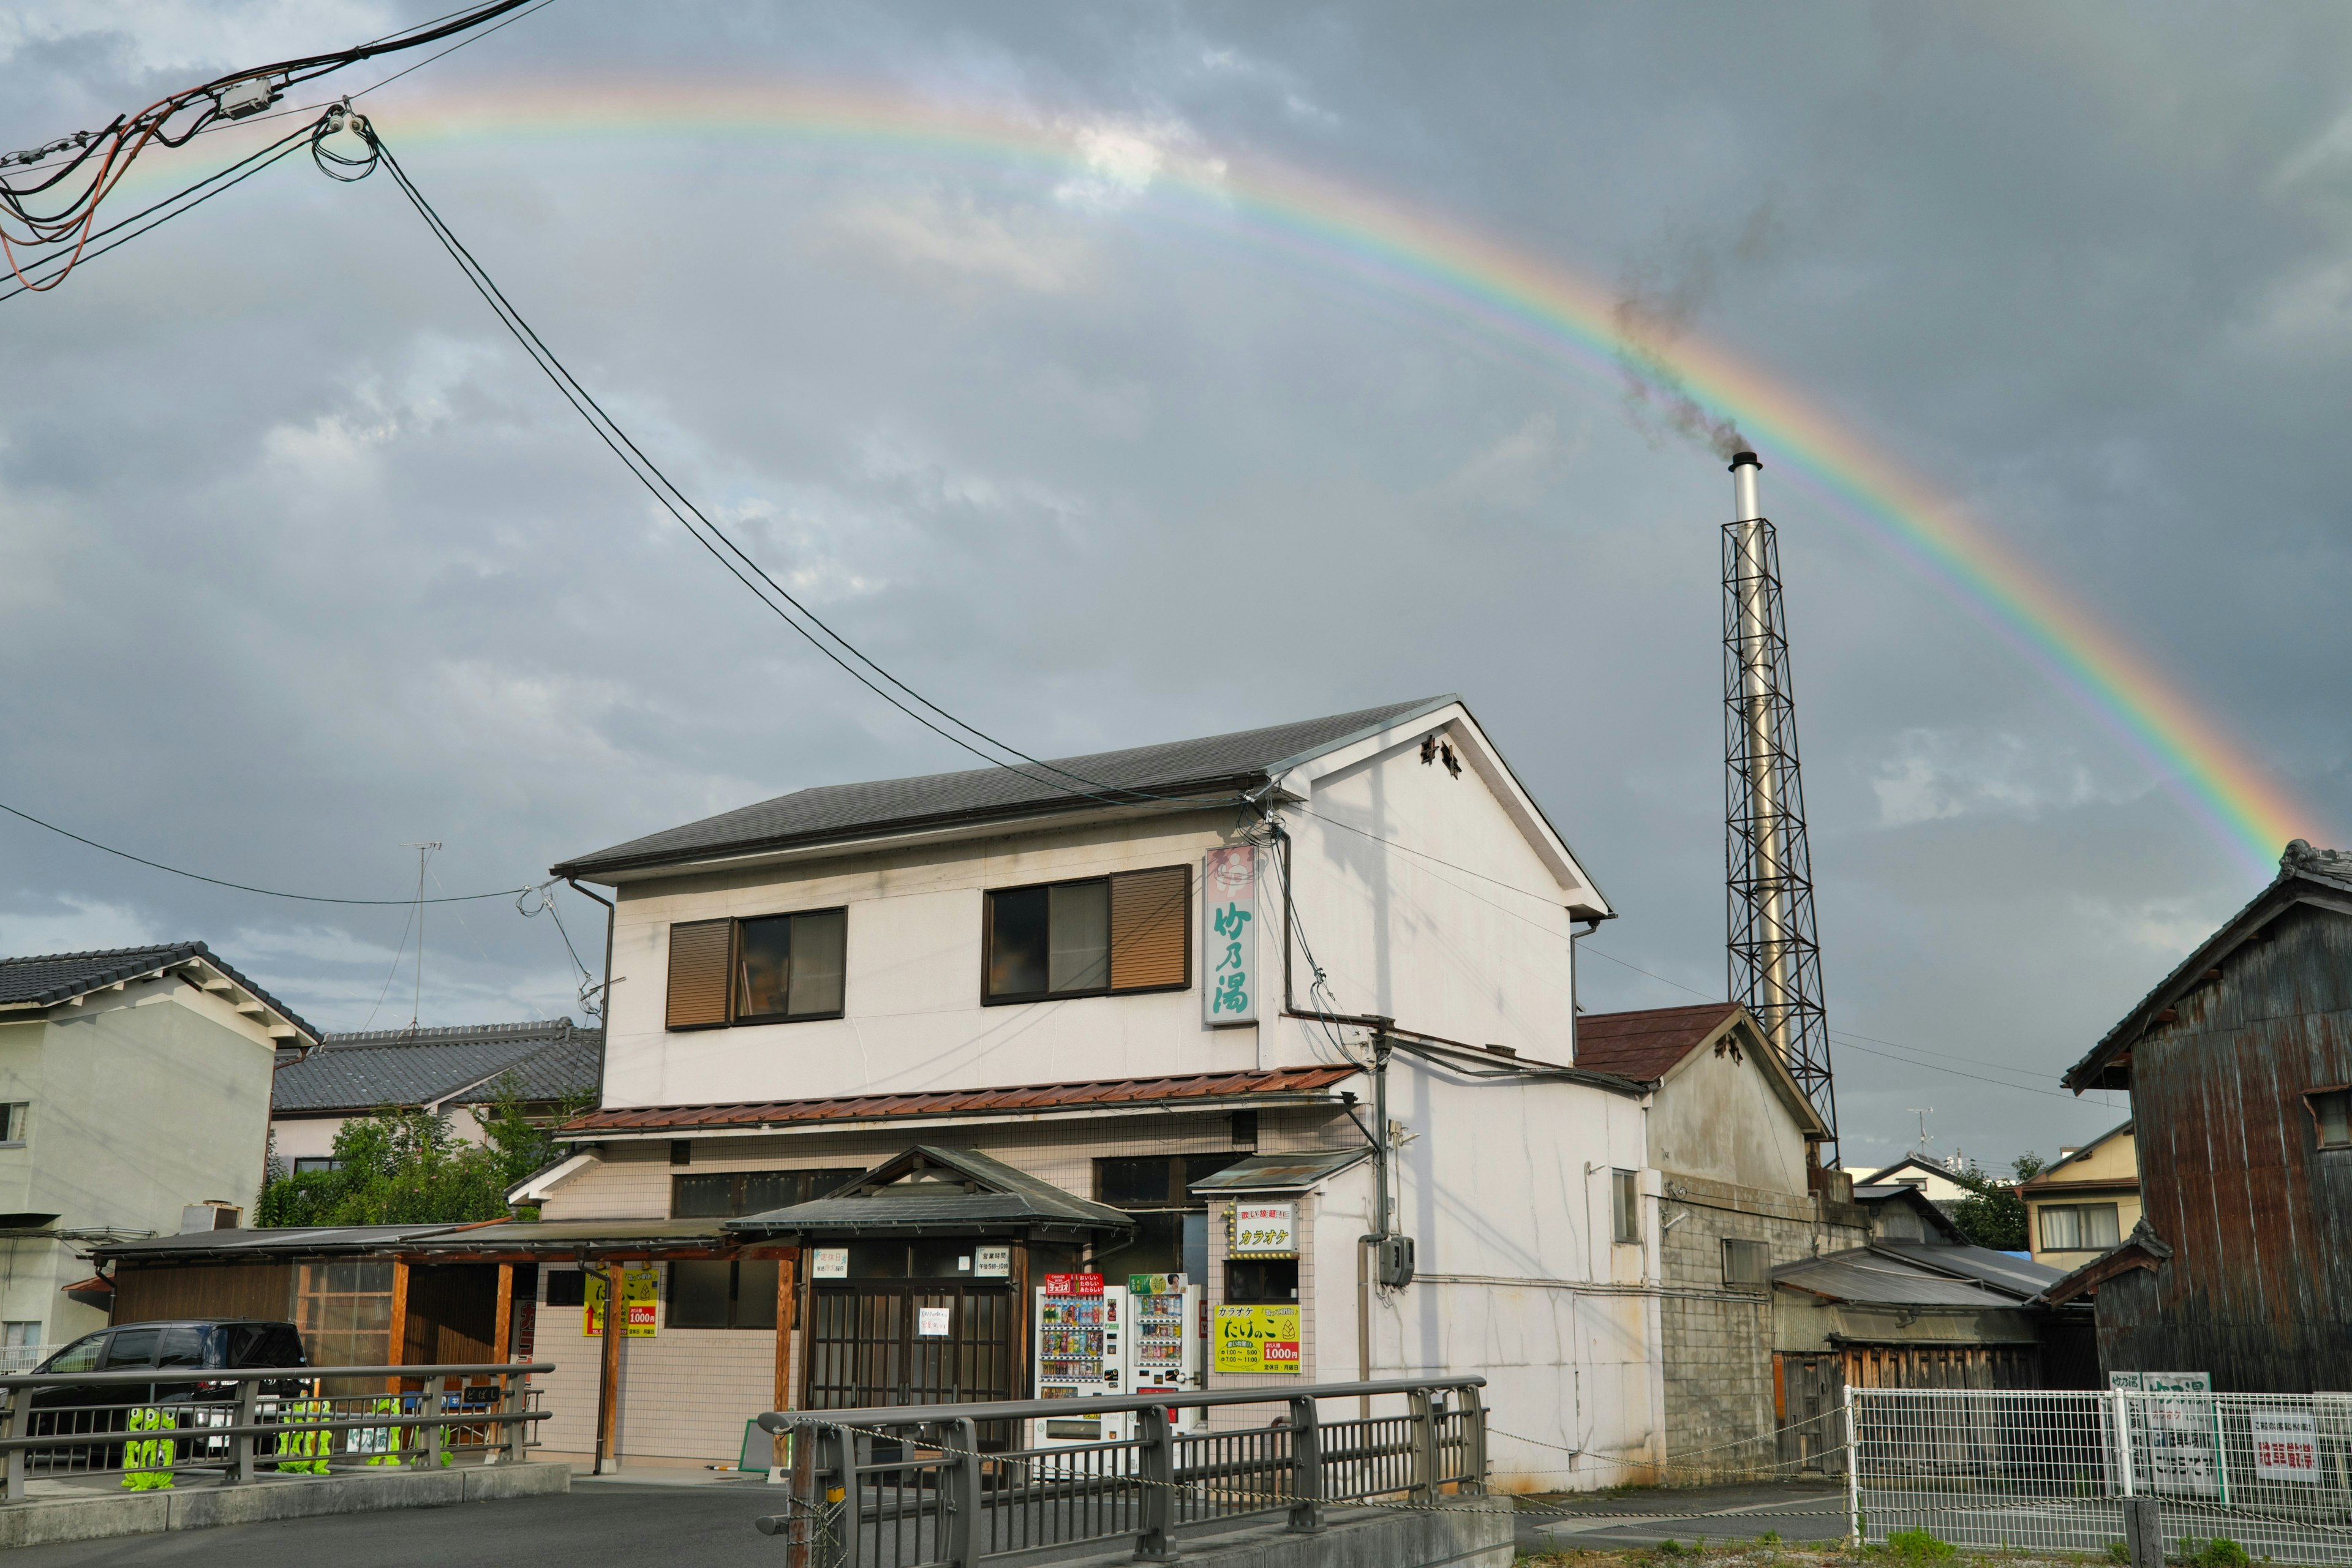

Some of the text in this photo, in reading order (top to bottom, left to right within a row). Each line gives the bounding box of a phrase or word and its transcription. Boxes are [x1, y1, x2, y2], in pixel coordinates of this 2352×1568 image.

[1213, 902, 1252, 1014] 竹乃湯
[1238, 1229, 1289, 1245] カラオケ
[821, 1253, 841, 1261] 定休日
[1049, 1283, 1069, 1292] チェリオ
[1218, 1307, 1253, 1317] カラオケ
[630, 1313, 655, 1323] 1,000円
[1224, 1318, 1276, 1338] たけのこ
[1265, 1349, 1298, 1359] 1,000円
[466, 1390, 496, 1400] どばし
[2258, 1441, 2315, 1469] 駐車厳禁
[2156, 1455, 2214, 1476] こちらです
